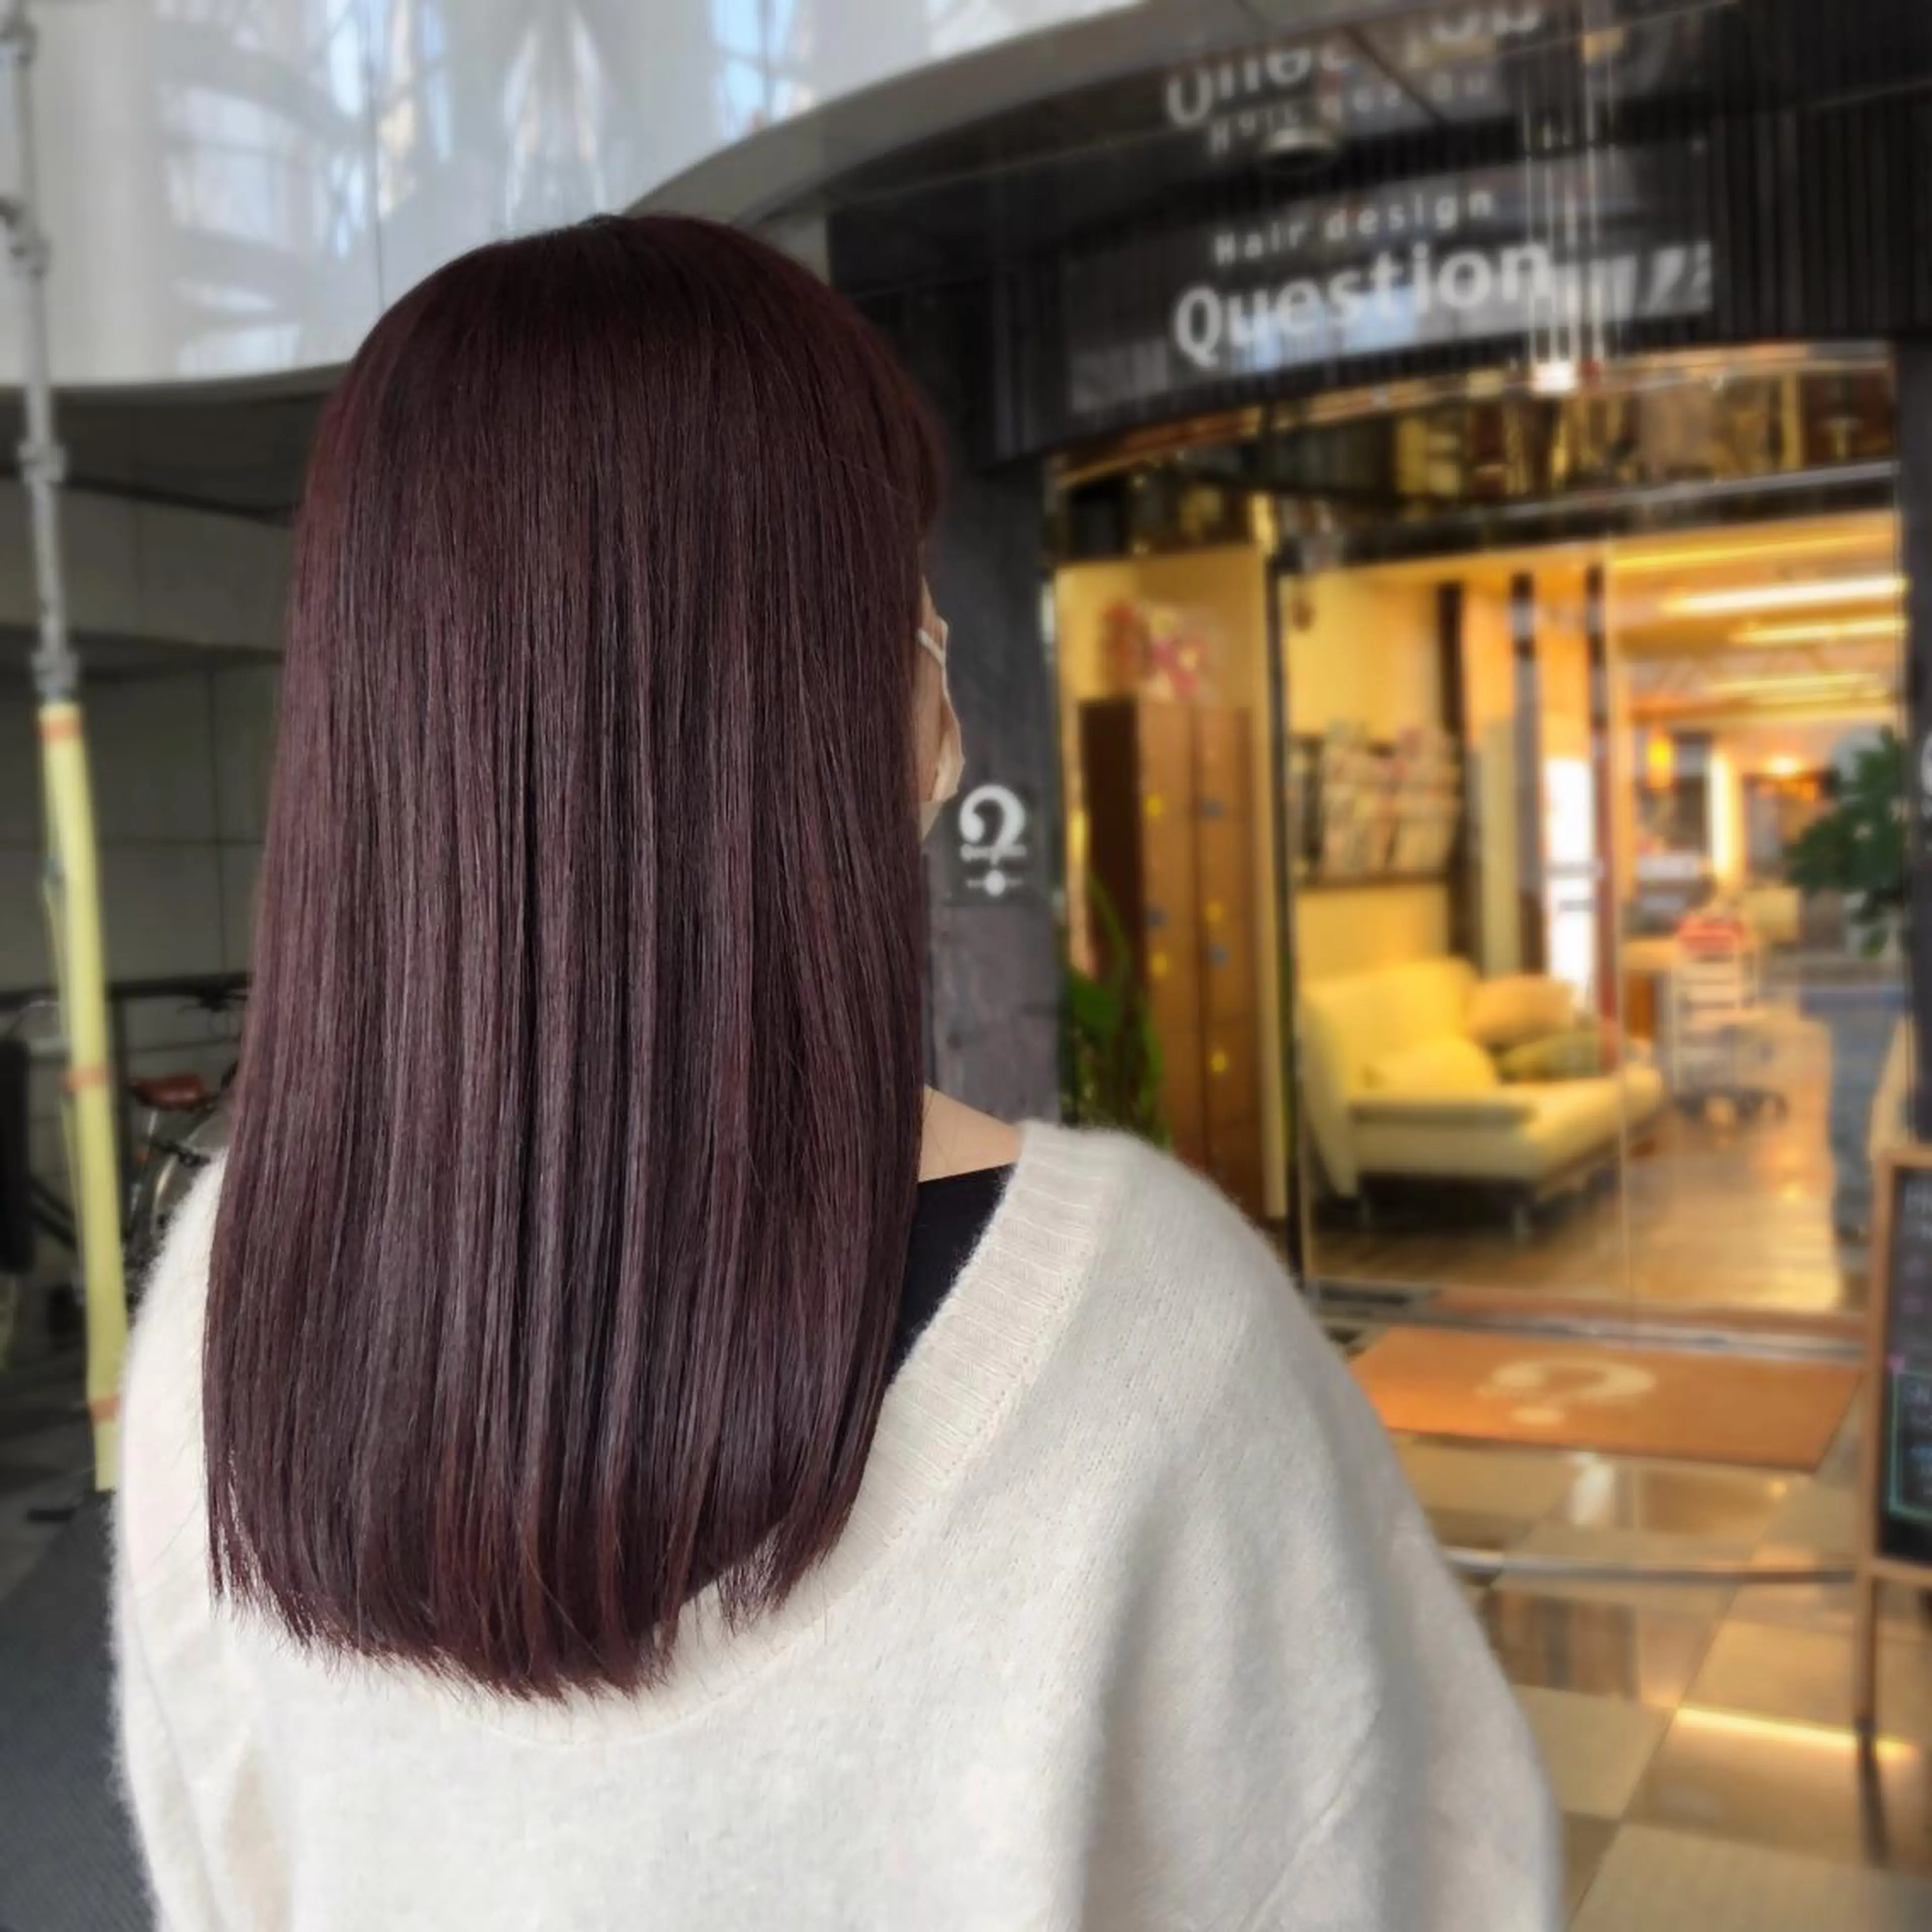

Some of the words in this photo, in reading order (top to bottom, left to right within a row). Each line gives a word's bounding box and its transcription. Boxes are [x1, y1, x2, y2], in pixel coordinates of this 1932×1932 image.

[1214, 221, 1304, 266] Hair
[1324, 190, 1493, 242] design
[1174, 242, 1552, 369] Question
